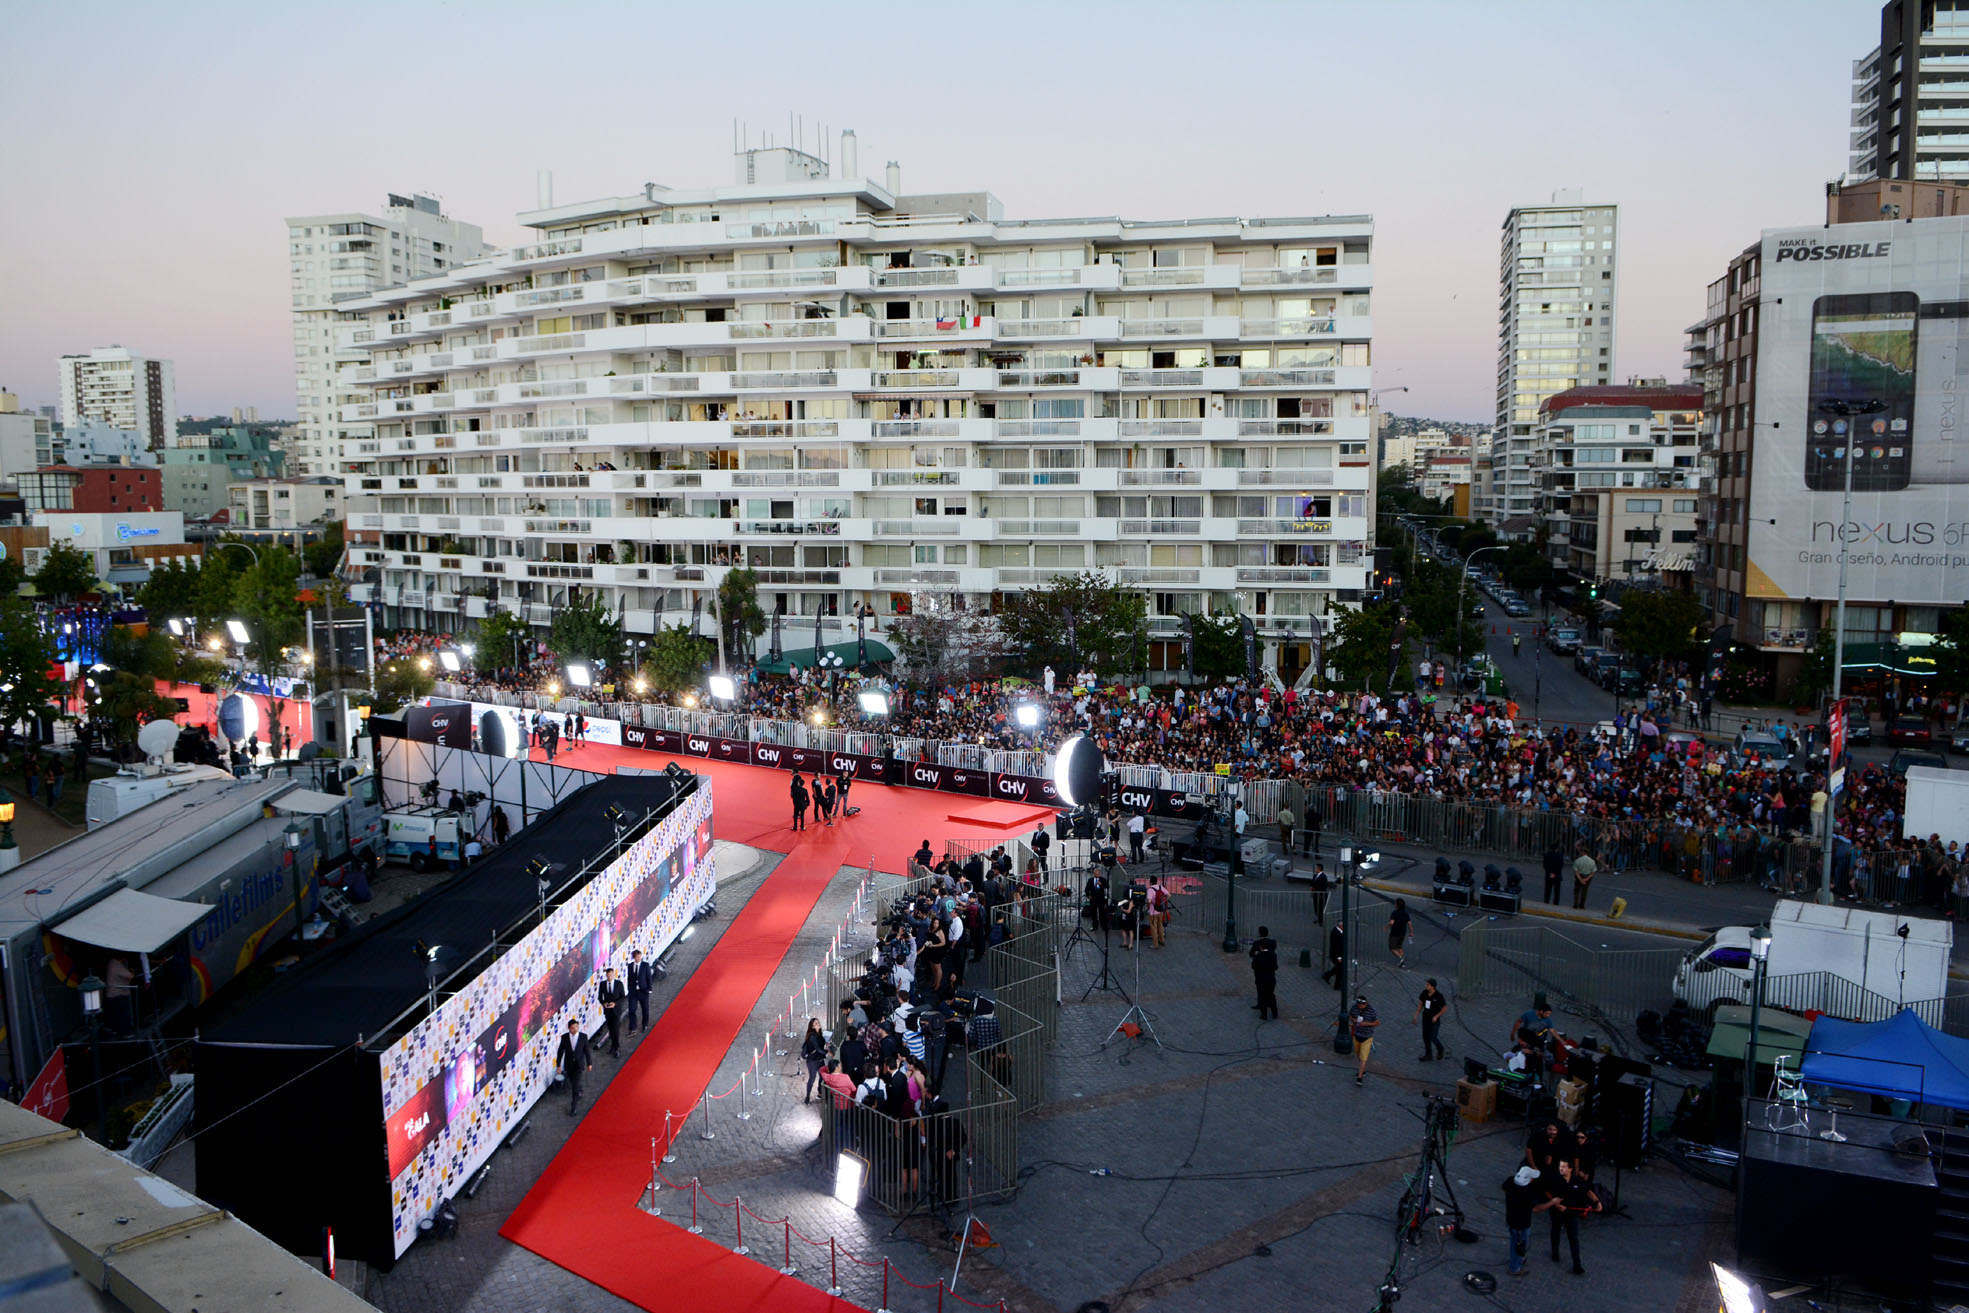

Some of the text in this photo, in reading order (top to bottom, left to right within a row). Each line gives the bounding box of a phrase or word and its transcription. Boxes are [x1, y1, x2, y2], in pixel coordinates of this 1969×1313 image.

[1779, 239, 1807, 247] MAKE
[1776, 242, 1891, 263] POSSIBLE
[1940, 379, 1957, 441] nexus
[1812, 521, 1935, 545] nexus
[1799, 550, 1832, 564] Gran
[1836, 551, 1887, 567] dseño,
[1891, 552, 1948, 567] Android
[627, 730, 645, 743] CHV
[689, 739, 709, 753] CHV
[758, 748, 780, 762] CHV
[833, 758, 856, 772] CHV
[914, 768, 939, 783] CHV
[999, 780, 1026, 795] CHV
[1121, 792, 1150, 808] CHV
[1170, 798, 1185, 806] CHV
